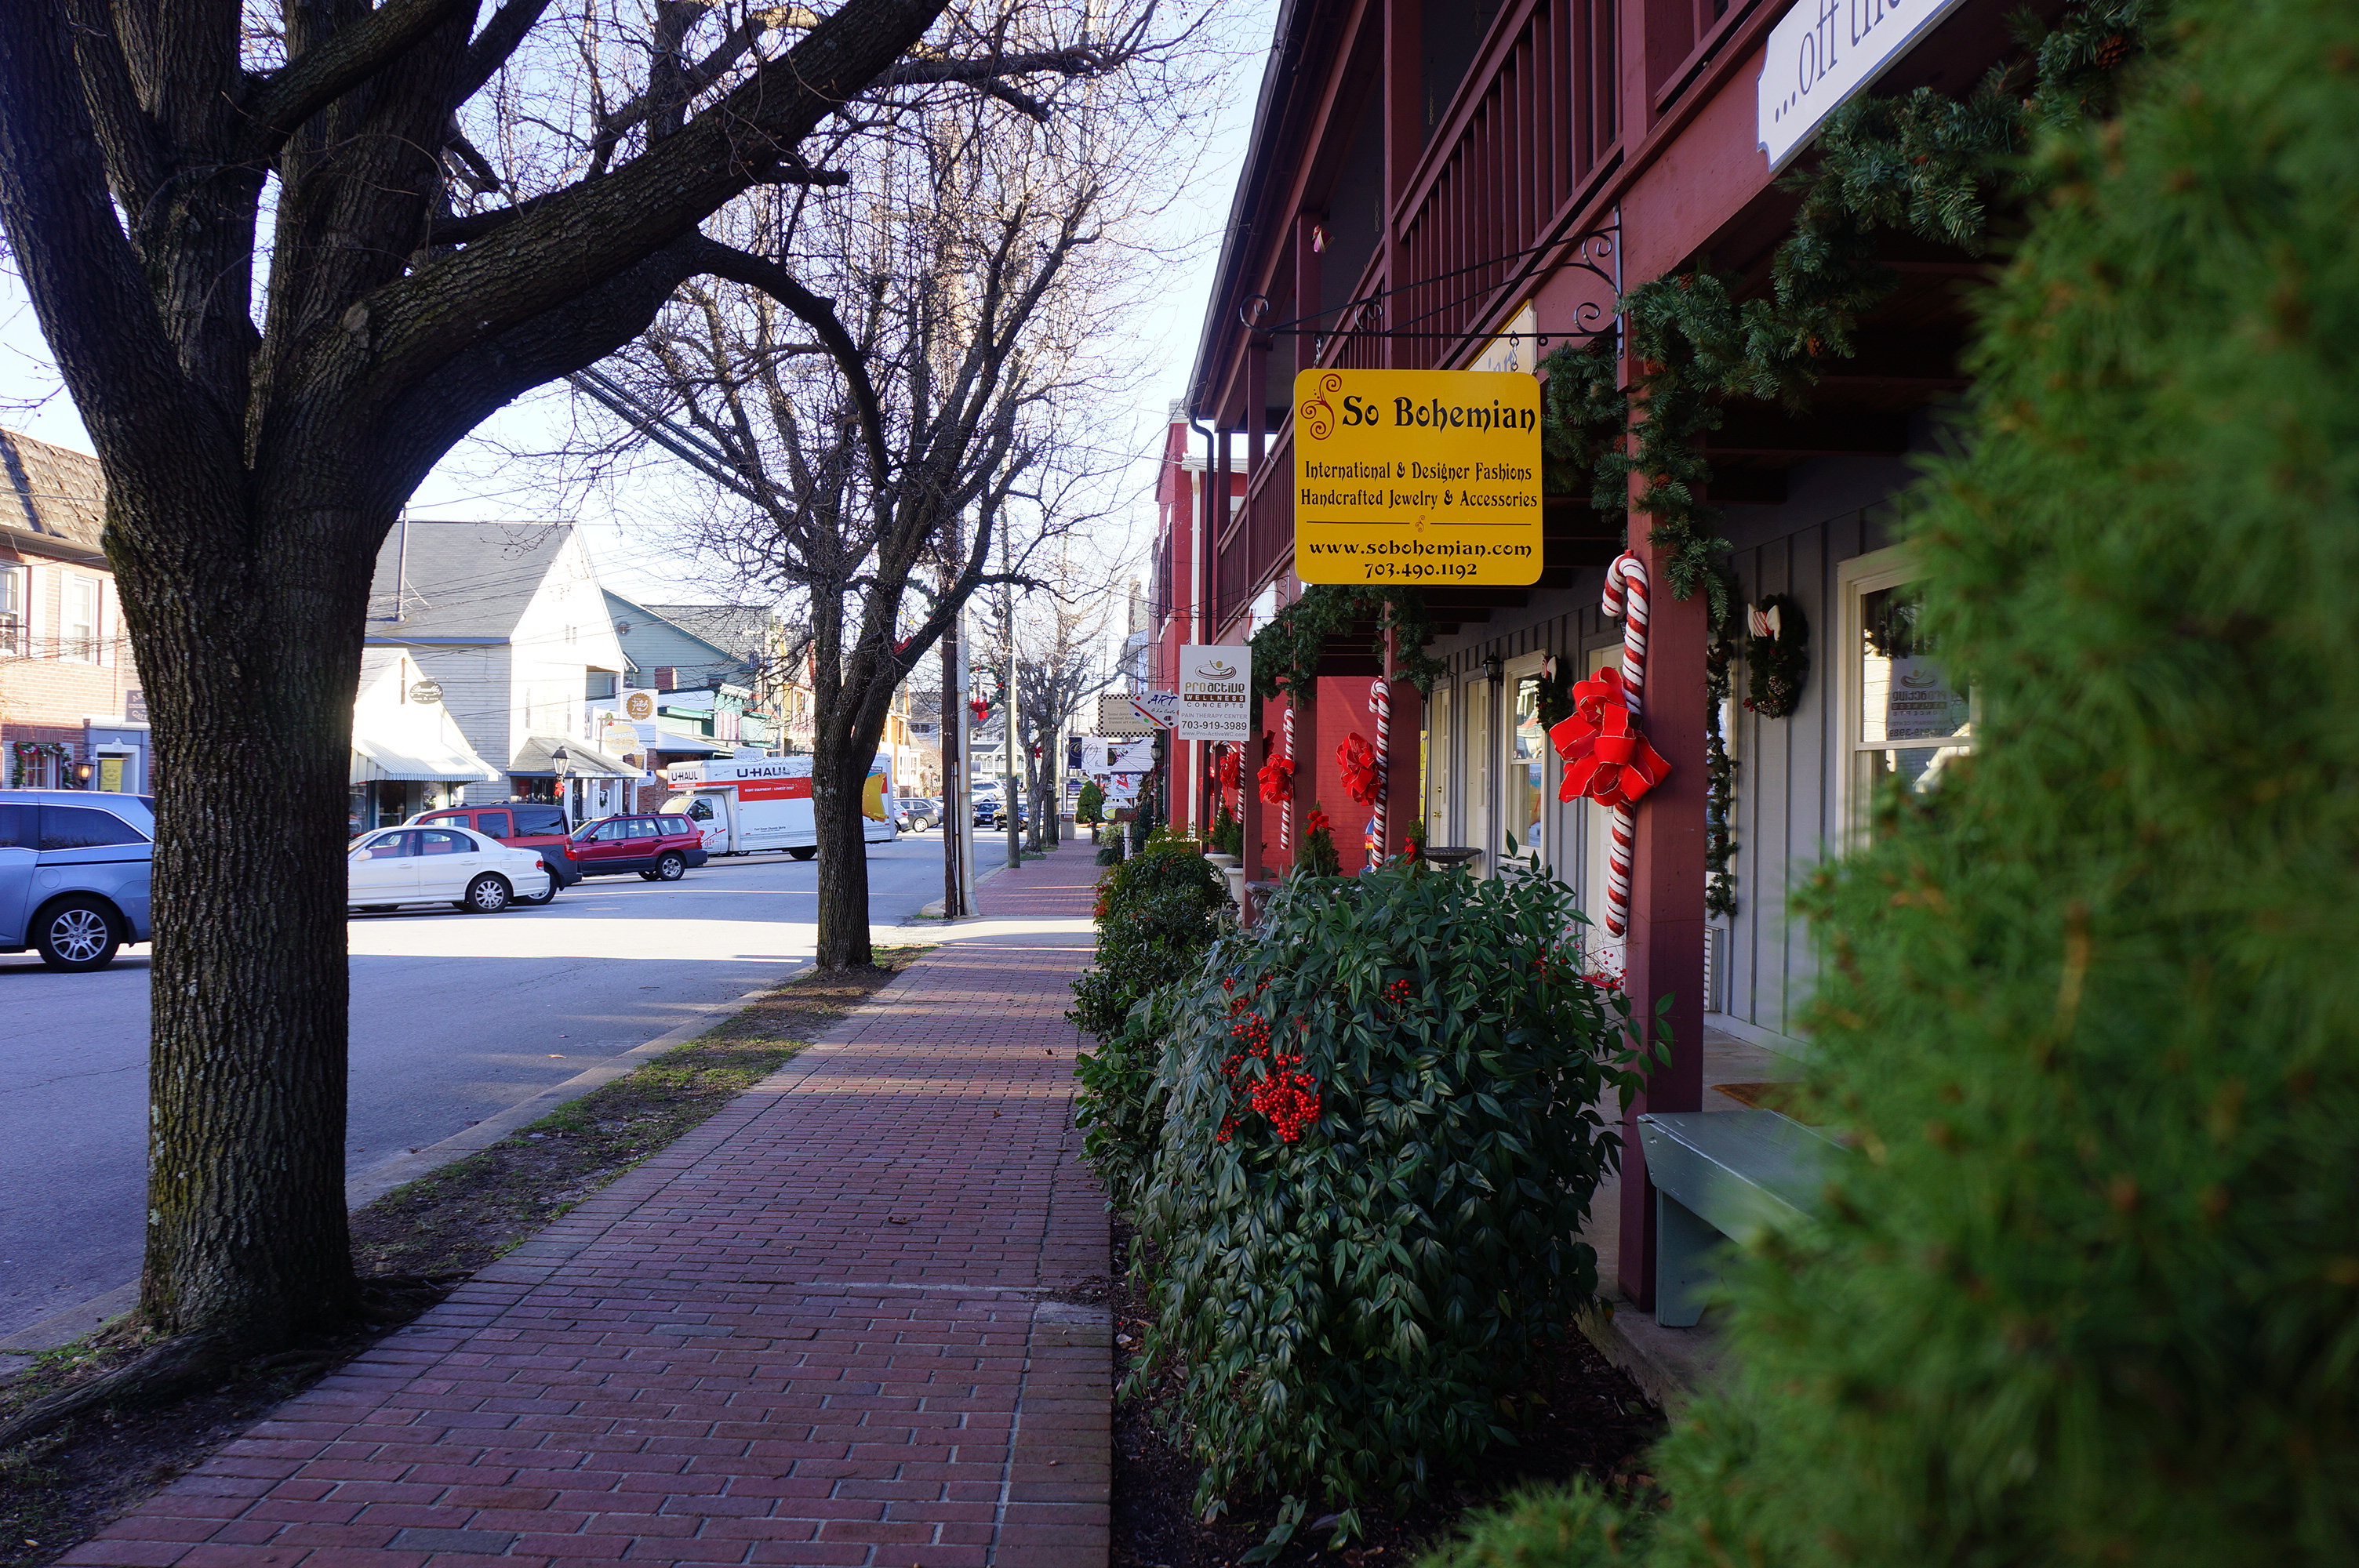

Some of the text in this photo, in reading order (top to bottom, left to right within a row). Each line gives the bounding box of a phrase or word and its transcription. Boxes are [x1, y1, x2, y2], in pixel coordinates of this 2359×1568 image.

[1342, 395, 1536, 435] So Bohemian
[1305, 461, 1532, 484] International & Designer Fashions
[1301, 489, 1537, 510] Handcrafted Jewelry & Accessories
[1309, 540, 1532, 558] www.sobohemian.com
[1364, 563, 1478, 579] 703.490.1192
[1147, 695, 1178, 706] ART
[1181, 720, 1247, 730] 703-919-3989
[671, 771, 698, 781] U-HAUL
